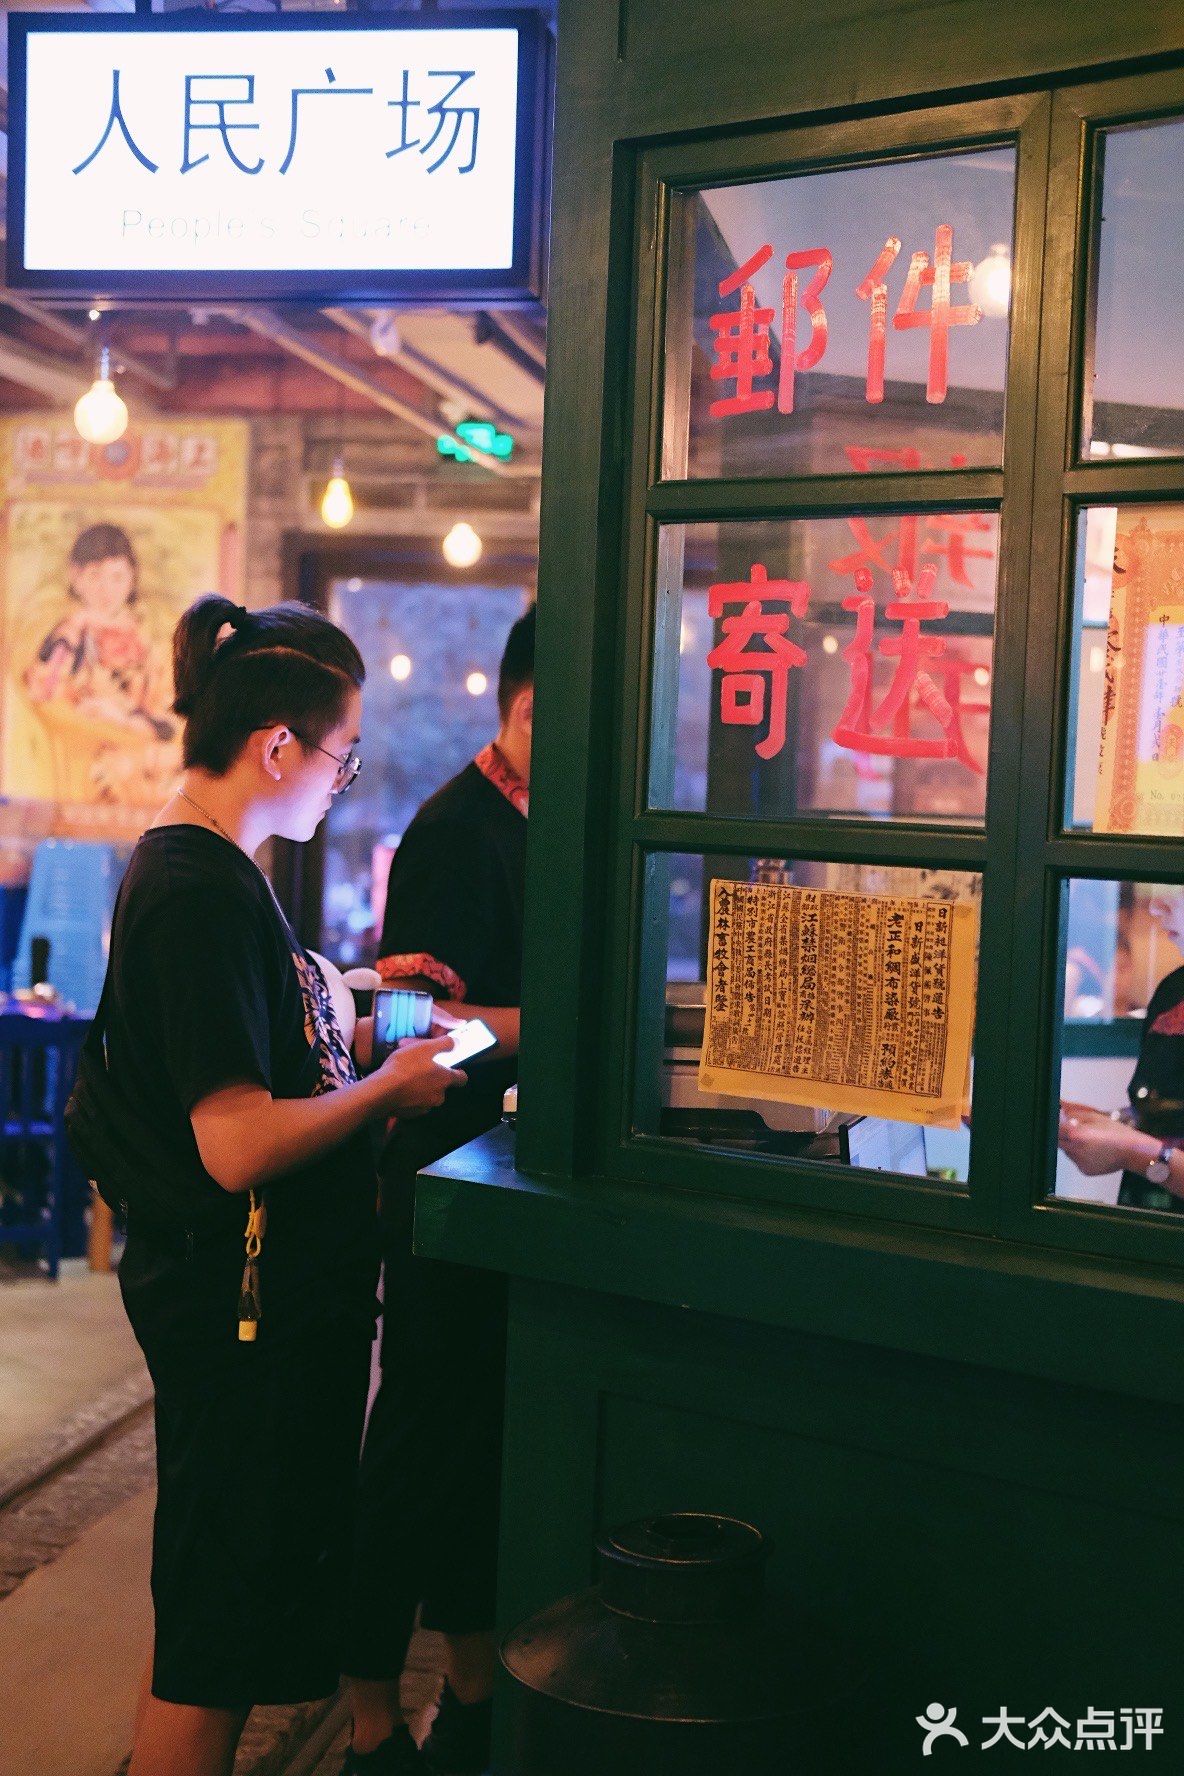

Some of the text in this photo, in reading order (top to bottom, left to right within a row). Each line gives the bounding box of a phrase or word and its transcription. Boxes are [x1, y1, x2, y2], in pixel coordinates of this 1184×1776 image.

[72, 67, 481, 176] 人民广场
[121, 208, 431, 248] People's Square
[709, 224, 982, 418] 郵件
[707, 563, 960, 760] 寄送
